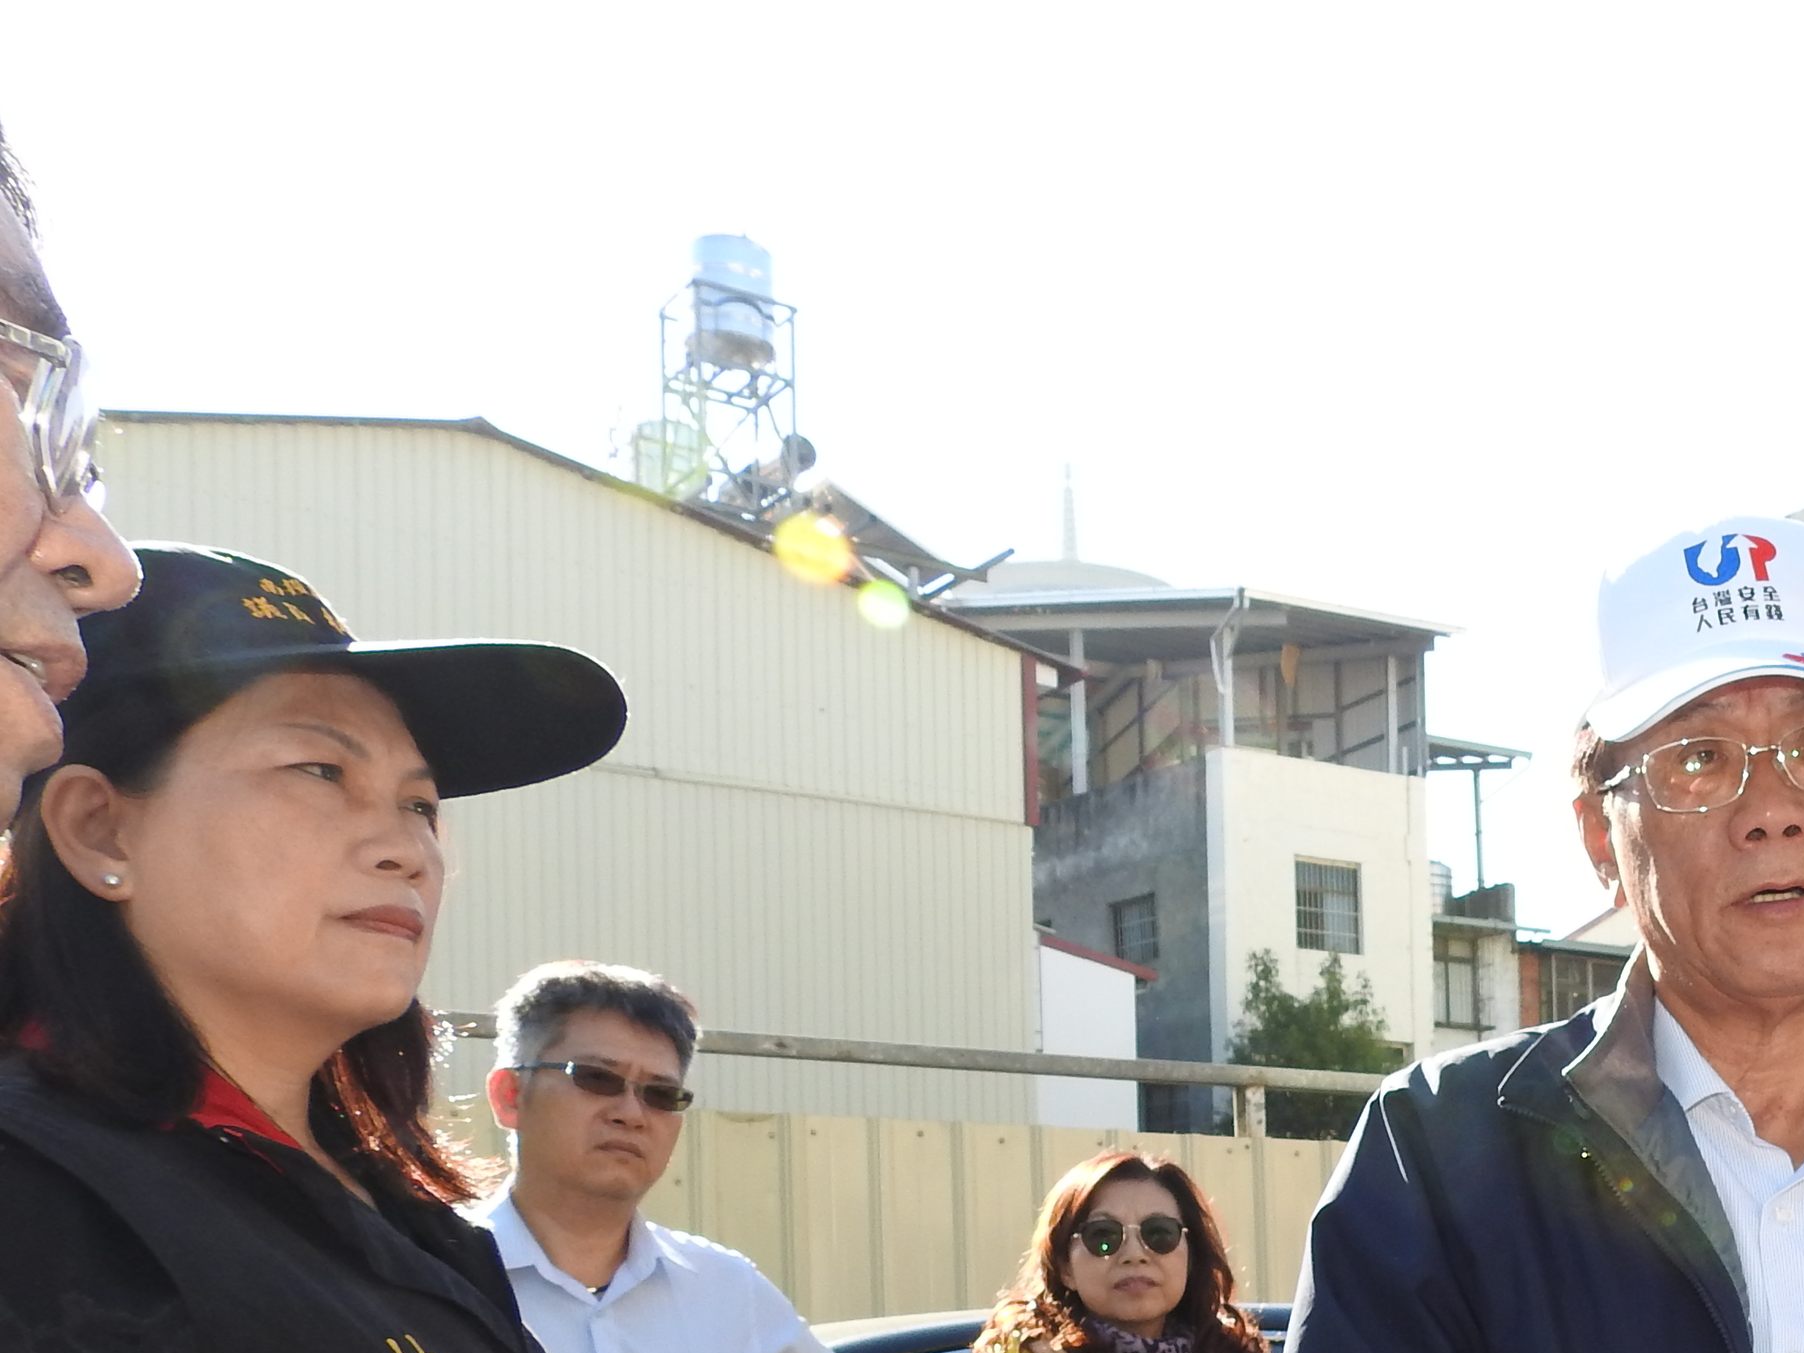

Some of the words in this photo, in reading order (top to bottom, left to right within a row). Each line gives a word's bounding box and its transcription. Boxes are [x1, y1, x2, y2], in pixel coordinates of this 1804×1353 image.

[1683, 533, 1777, 586] UP
[1692, 585, 1781, 614] 台灣安全
[1696, 604, 1785, 633] 人民有錢
